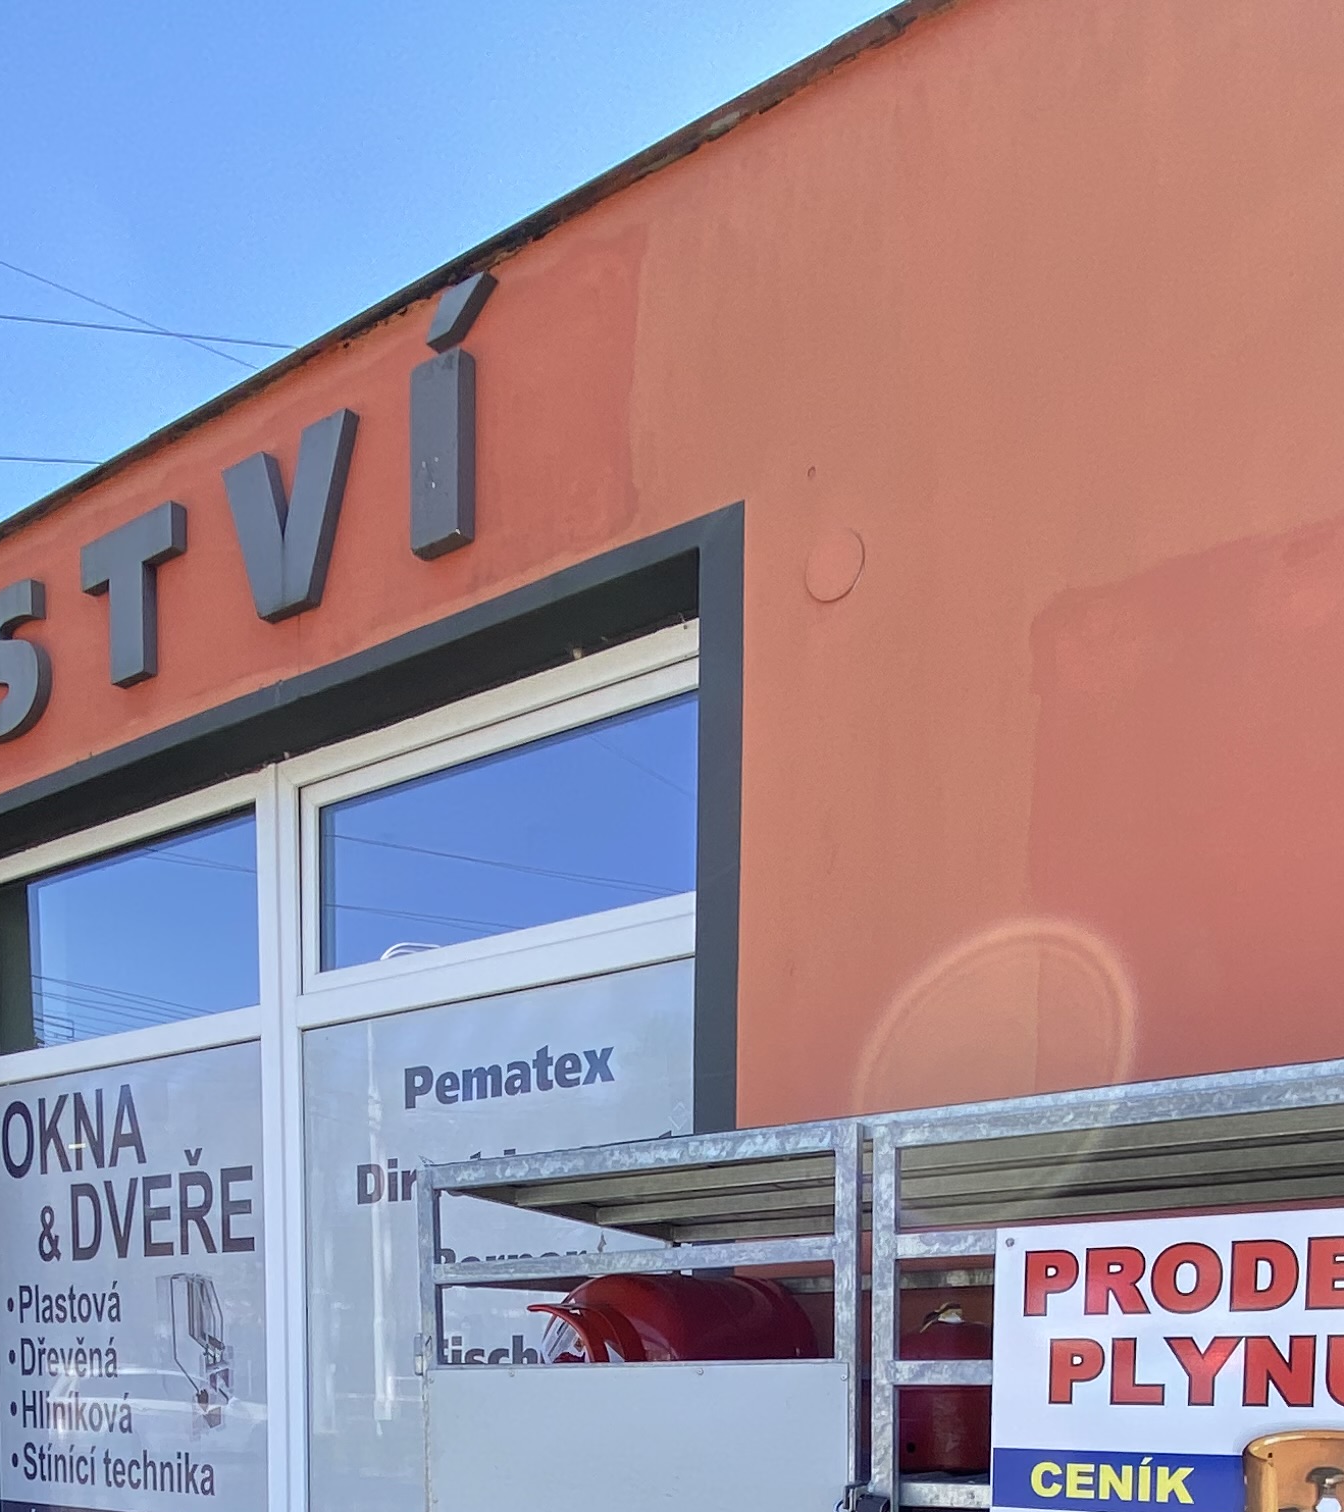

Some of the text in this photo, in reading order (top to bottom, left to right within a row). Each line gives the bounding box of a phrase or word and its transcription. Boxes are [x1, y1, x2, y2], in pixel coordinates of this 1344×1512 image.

[404, 1045, 615, 1110] Pematex
[2, 1084, 147, 1179] OKNA
[38, 1147, 255, 1262] & DVEŘE
[19, 1280, 121, 1324] Plastová
[20, 1336, 118, 1378] Dřevěná
[22, 1390, 133, 1434] Hliníková
[23, 1442, 215, 1496] Stínící technika
[1030, 1457, 1194, 1504] CENÍK
